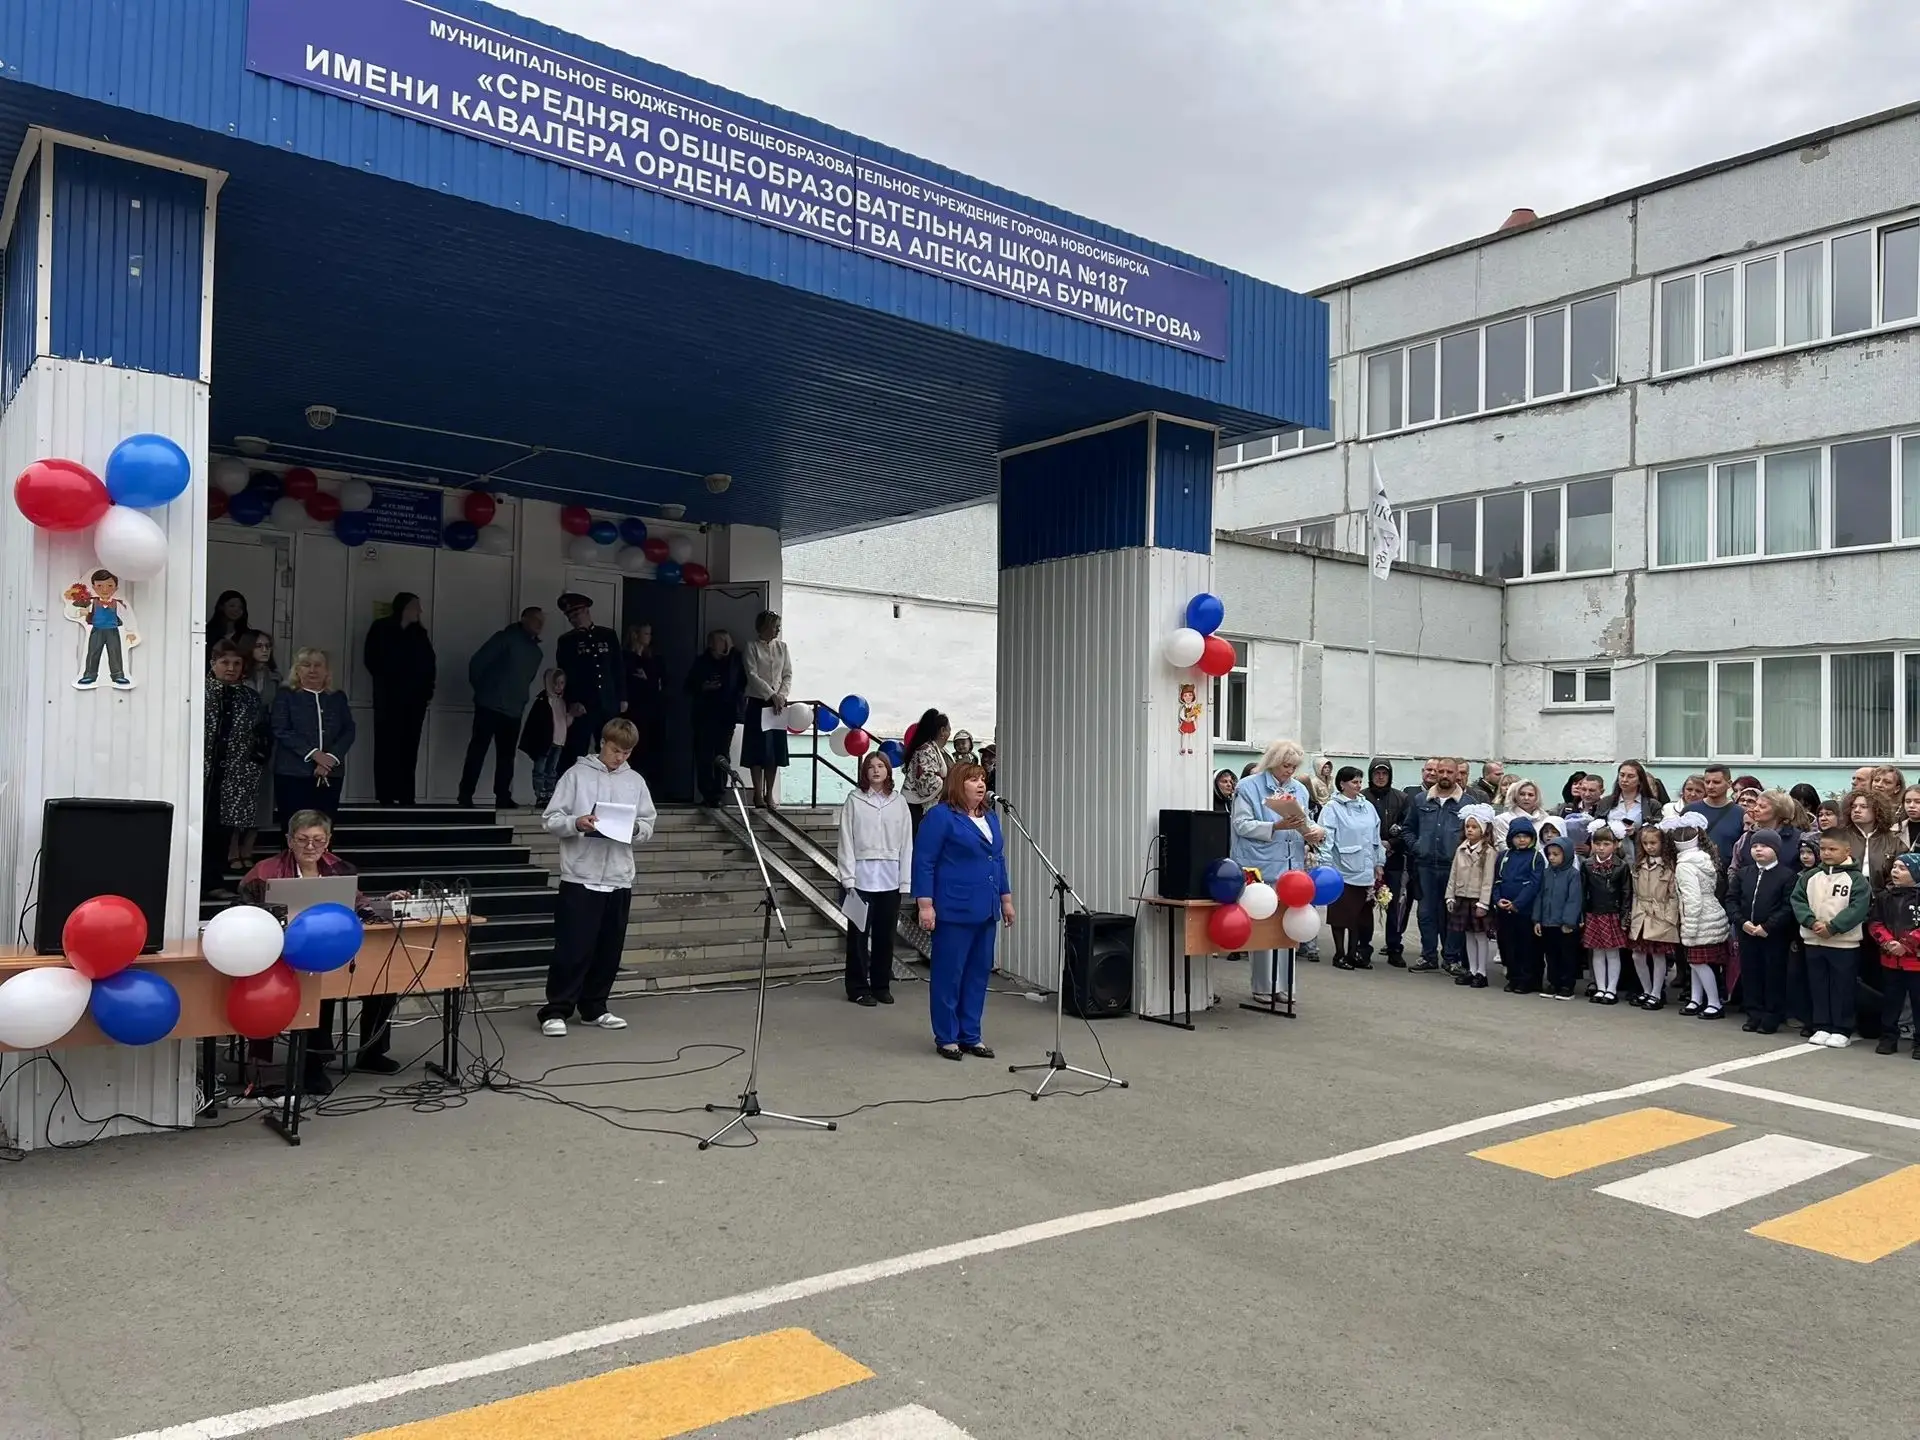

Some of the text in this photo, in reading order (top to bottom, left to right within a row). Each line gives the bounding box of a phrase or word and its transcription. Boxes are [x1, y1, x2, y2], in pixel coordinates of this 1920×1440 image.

[306, 44, 1201, 342] ИМЕНИ КАВАЛЕРА ОРДЕНА МУЖЕСТВА АЛЕКСАНДРА БУРМИСТРОВА»
[430, 19, 1150, 277] МУНИЦИПАЛЬНОЕ БЮДЖЕТНОЕ ОБЩЕОБРАЗОВАТЕЛЬНОЕ УЧРЕЖДЕНИЕ ГОРОДА НОВОСИБИРСКА
[477, 73, 1128, 296] «СРЕДНЯЯ ОБЩЕОБРАЗОВАТЕЛЬНАЯ ШКОЛА №187
[1831, 884, 1849, 897] FG
